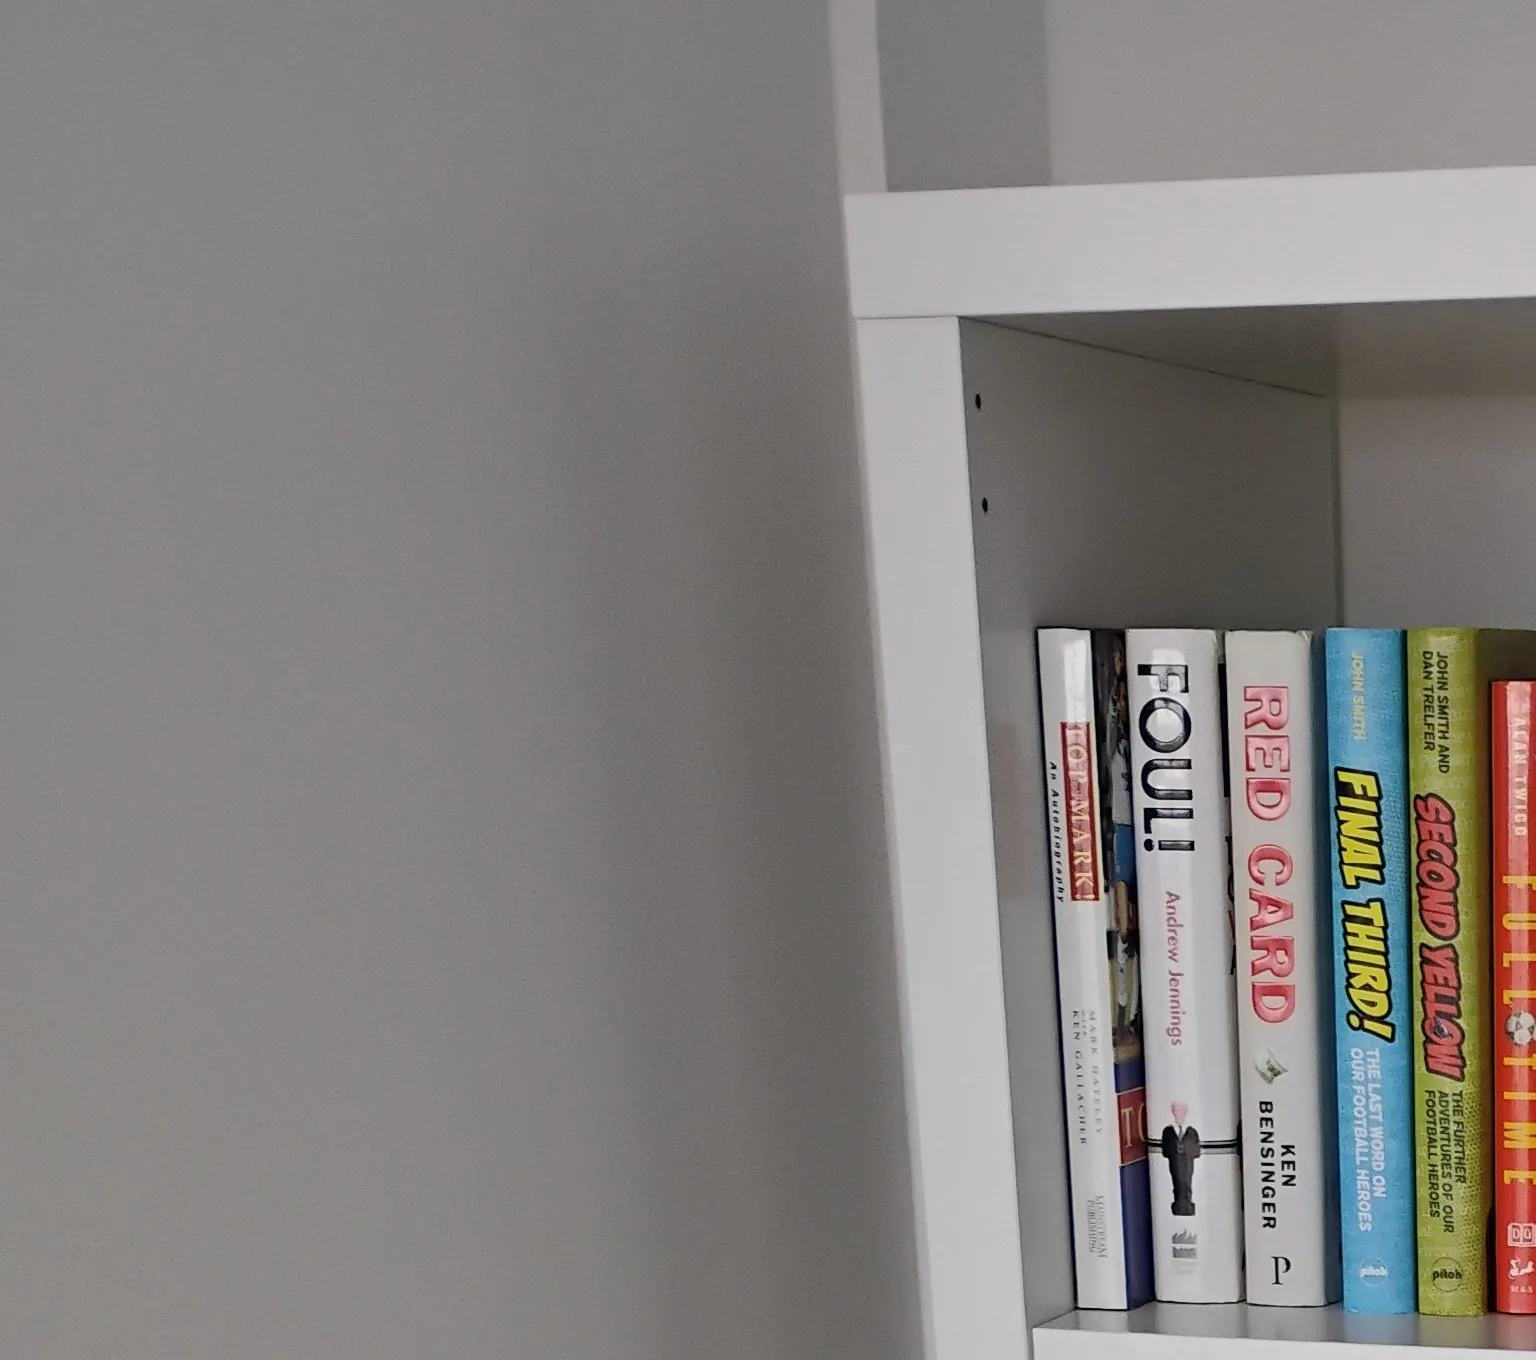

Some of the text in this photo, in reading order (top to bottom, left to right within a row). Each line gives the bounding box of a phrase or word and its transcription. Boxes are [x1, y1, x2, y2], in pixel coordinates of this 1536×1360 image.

[1137, 664, 1196, 852] FOUL!
[1352, 652, 1367, 741] JOHN SMITH
[1422, 651, 1436, 752] DAN TRELFER
[1437, 652, 1450, 774] JOHN SMITH AND
[1512, 717, 1529, 765] ALAN
[1050, 761, 1064, 903] An Autobiography
[1070, 800, 1096, 899] MARK!
[1244, 686, 1296, 1024] RED CARD
[1165, 890, 1187, 1046] Andrew Jennings
[1335, 767, 1396, 1043] FINAL THIRD!
[1414, 793, 1466, 1083] SECOND YELLOW
[1072, 1010, 1081, 1041] KEN
[1258, 1100, 1277, 1229] BENSINGER
[1280, 1144, 1296, 1187] KEN
[1350, 1048, 1372, 1232] OUR FOOTBALL HEROES
[1366, 1048, 1387, 1198] THE LAST WORD ON
[1424, 1090, 1440, 1218] FOOTBALL HEROES
[1438, 1091, 1455, 1233] ADVENTURES OF OUR
[1452, 1090, 1467, 1184] THE FURTHER
